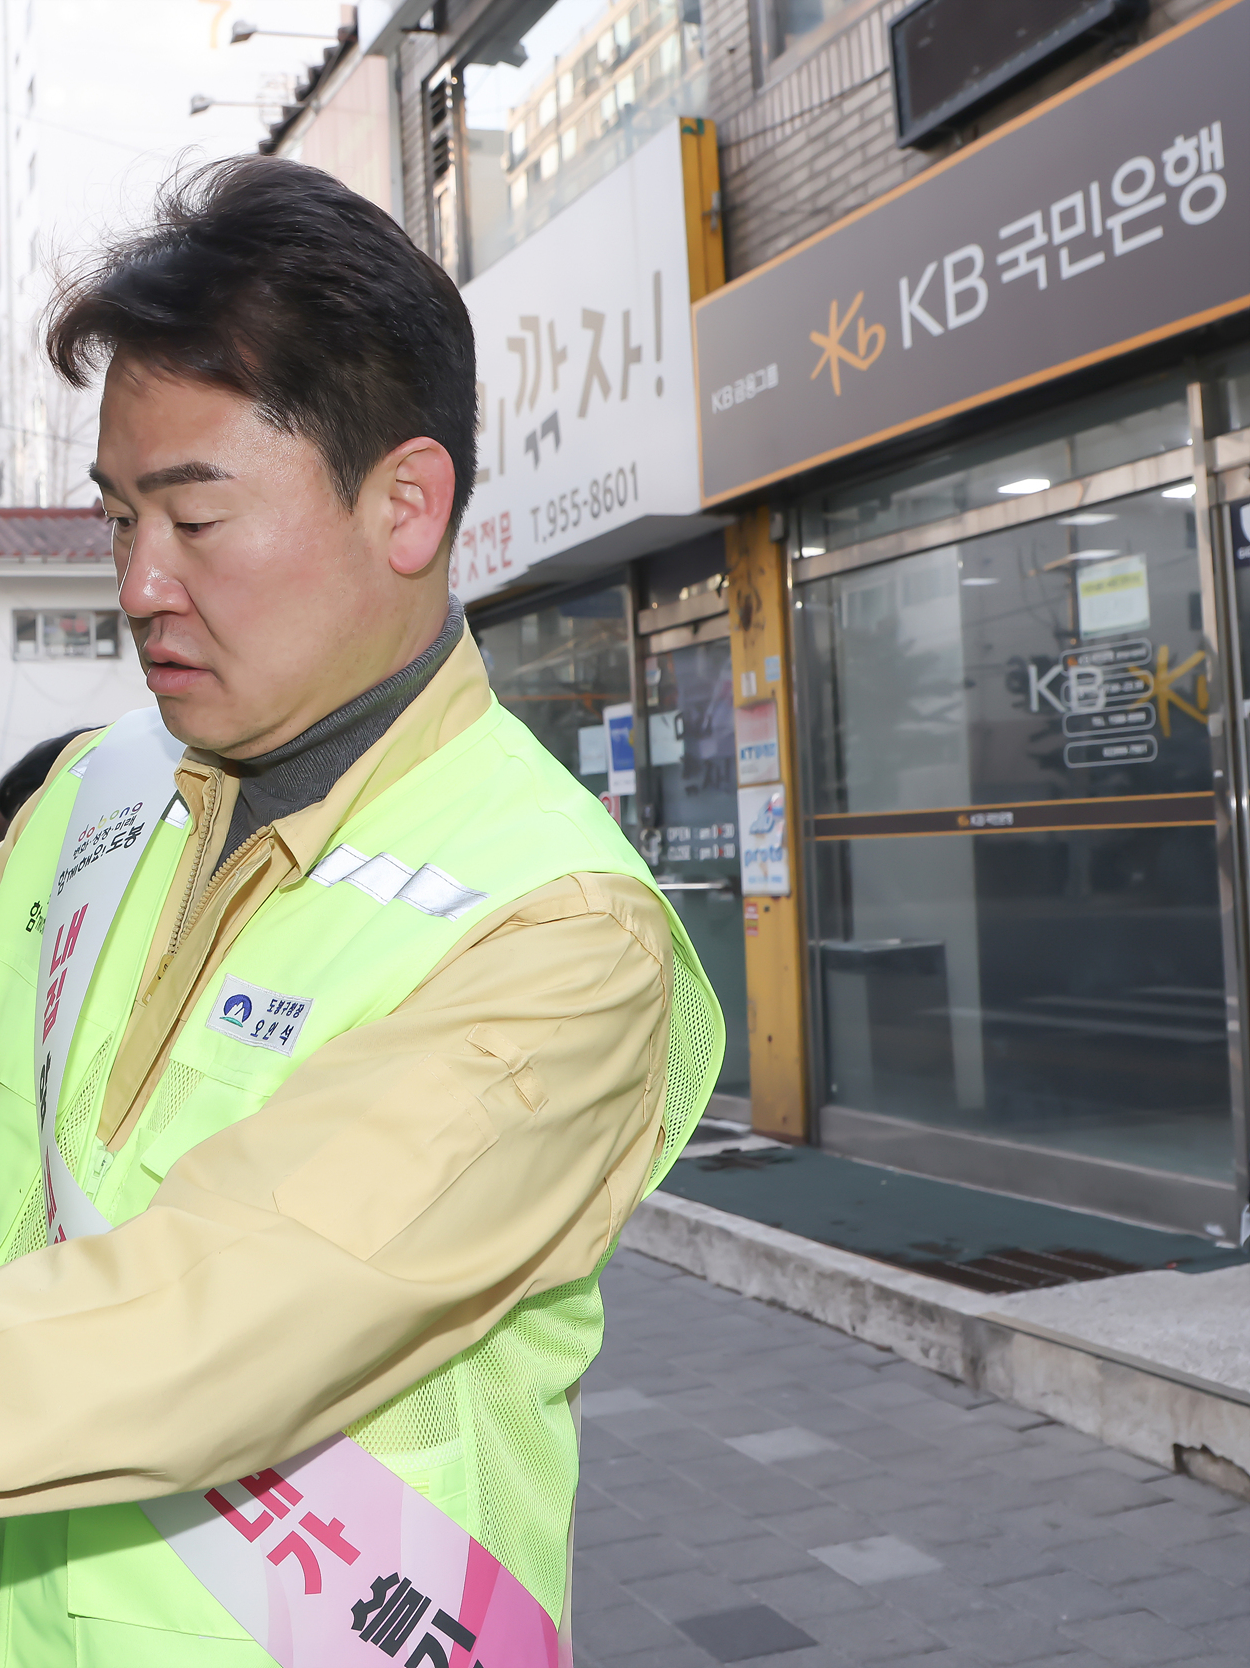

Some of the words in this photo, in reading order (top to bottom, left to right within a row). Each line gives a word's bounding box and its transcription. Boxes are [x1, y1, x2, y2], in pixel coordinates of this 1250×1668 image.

[898, 120, 1228, 350] KB국민은행
[530, 461, 640, 546] T.955-8601
[266, 998, 306, 1019] 도봉구청장
